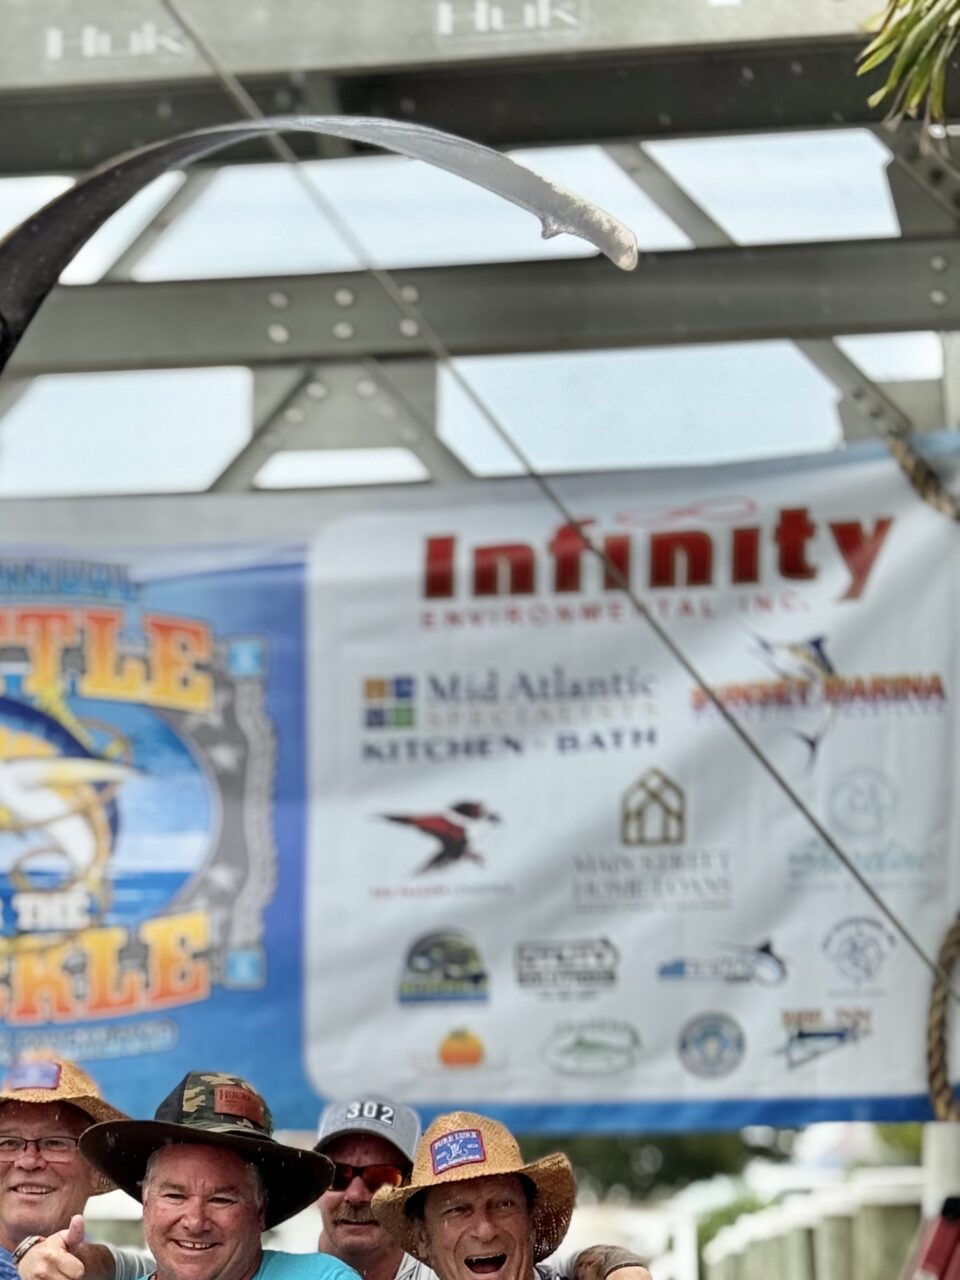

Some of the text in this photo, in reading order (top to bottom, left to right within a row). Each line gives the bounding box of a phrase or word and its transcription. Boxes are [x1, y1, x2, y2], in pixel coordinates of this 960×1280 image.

[423, 507, 895, 602] Infinity
[426, 665, 659, 703] Mid Atlantic
[363, 726, 658, 763] KITCHEN BATH
[12, 890, 93, 930] THE
[346, 1101, 395, 1125] 302
